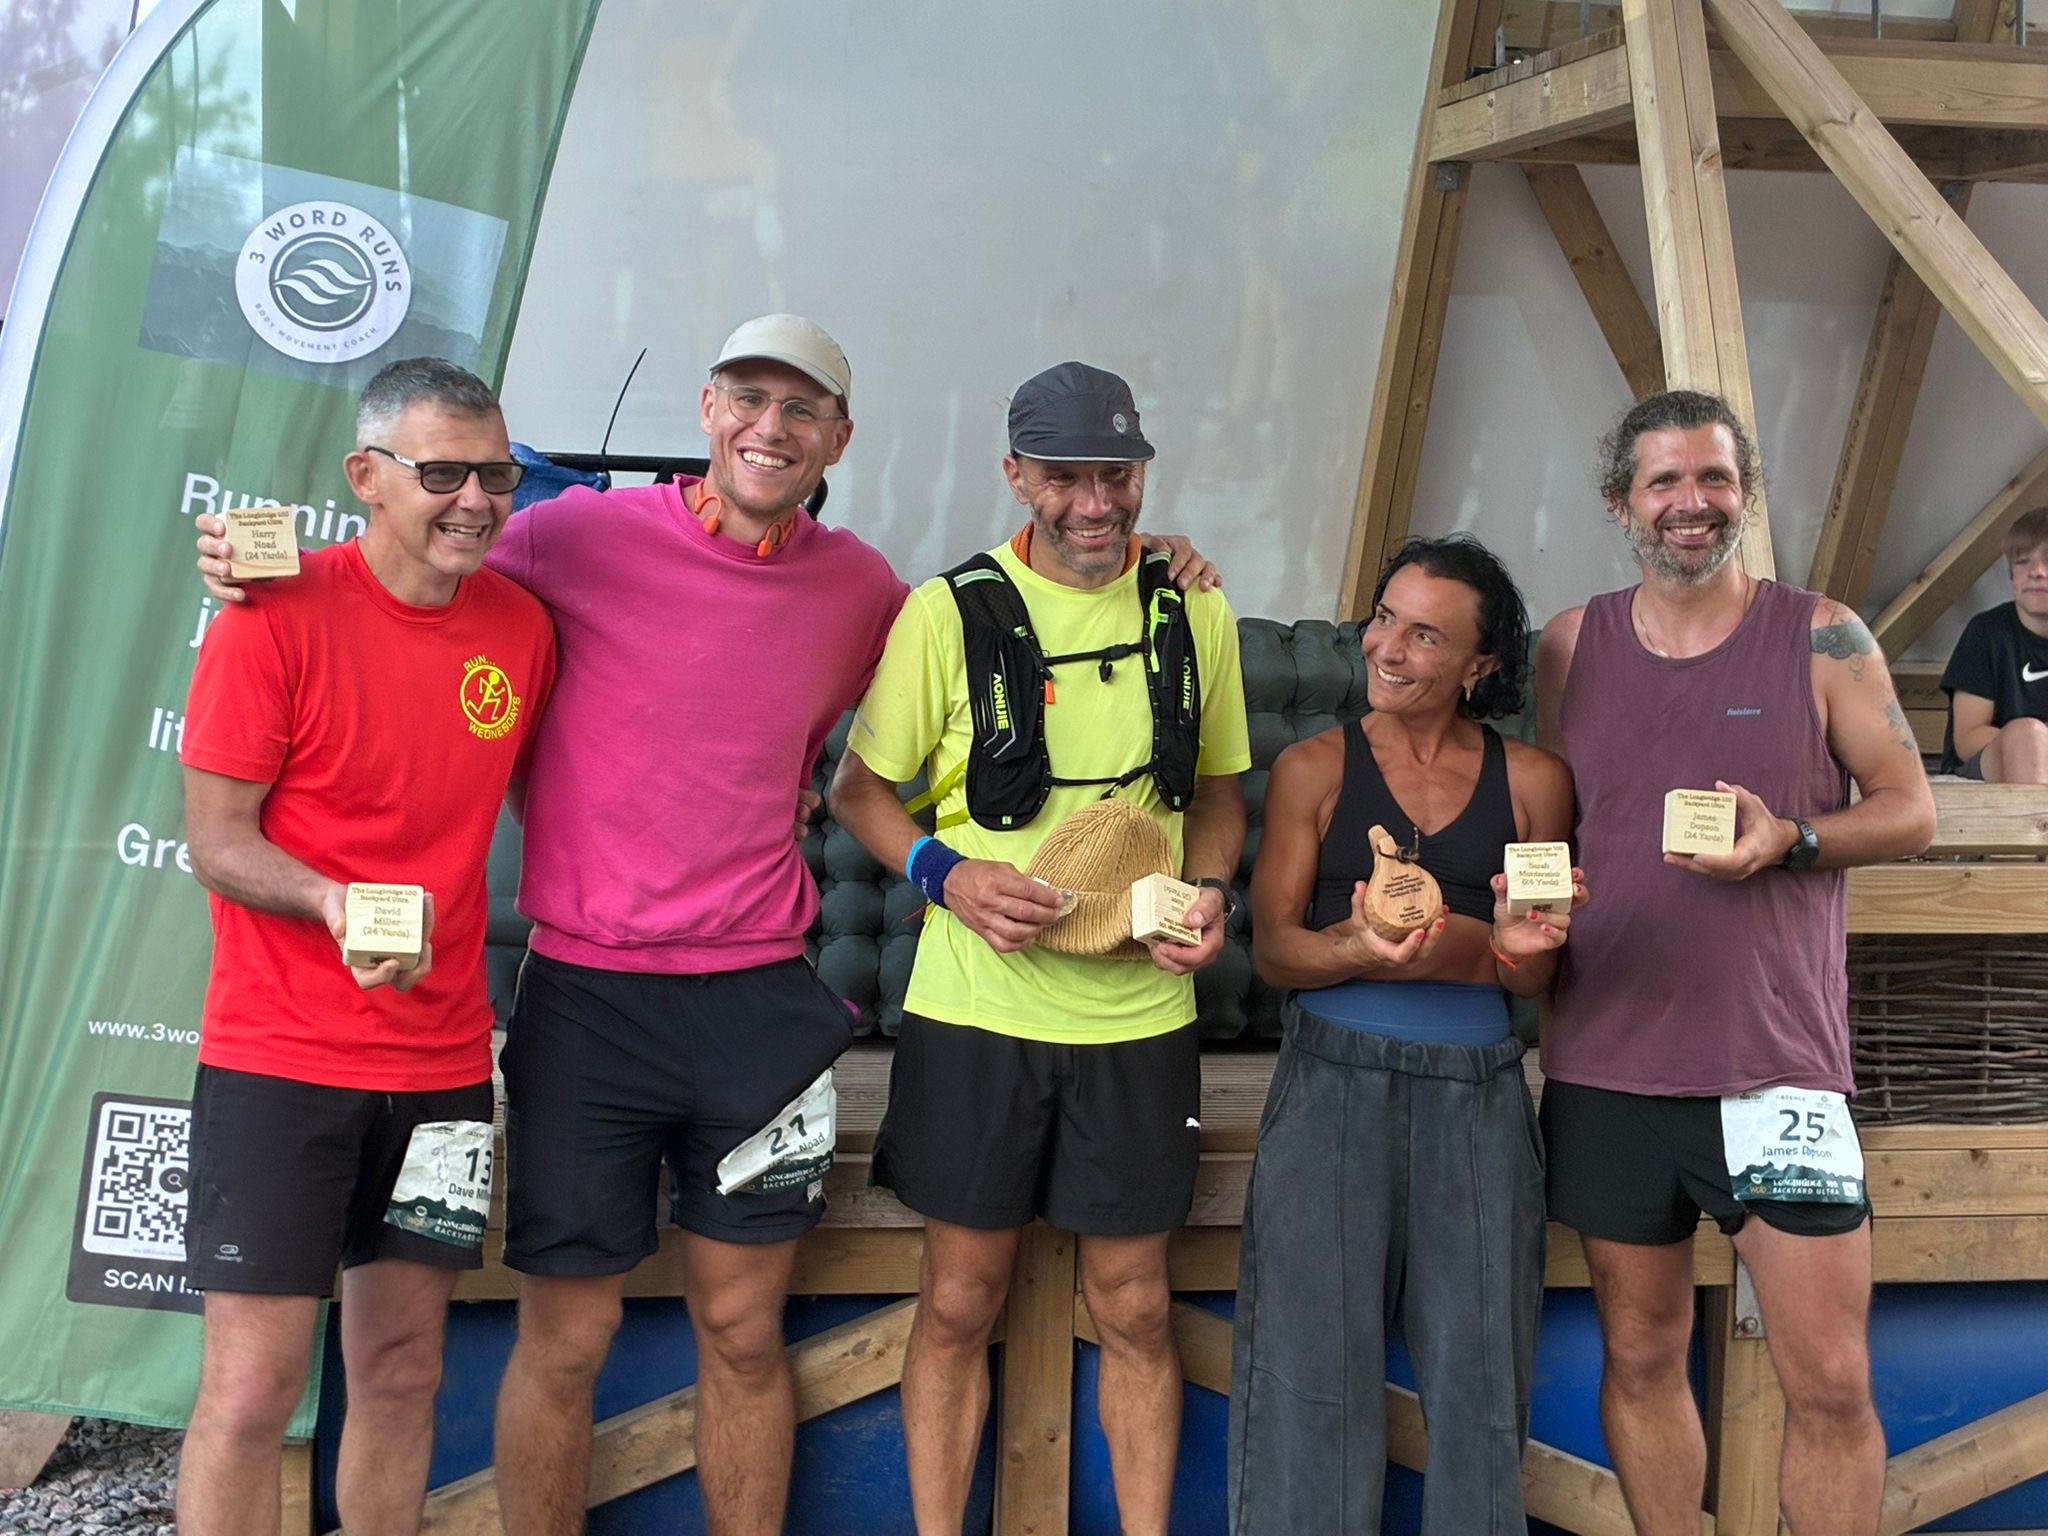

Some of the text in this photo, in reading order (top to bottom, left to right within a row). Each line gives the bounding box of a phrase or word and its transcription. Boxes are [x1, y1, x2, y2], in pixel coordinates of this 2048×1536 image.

[249, 210, 402, 292] 3 WORD RUNS
[255, 303, 377, 351] BODY MOVEMENT COACH
[251, 530, 277, 539] Harry
[245, 550, 288, 561] (24 Yards)
[993, 673, 1010, 730] AONIJIE
[468, 696, 521, 740] WEDNESDAYS
[1693, 812, 1717, 821] James
[373, 917, 401, 926] Miller
[374, 906, 401, 916] David
[363, 926, 379, 936] (24
[88, 1020, 200, 1044] www.3wo
[765, 1113, 808, 1156] 21
[1779, 1109, 1826, 1143] 25
[798, 1132, 826, 1153] Noad
[1762, 1145, 1799, 1157] James
[465, 1148, 492, 1186] 13
[448, 1183, 475, 1198] Dave
[1772, 1186, 1814, 1195] BACKYARD
[1816, 1187, 1840, 1196] ULTRA
[103, 1268, 174, 1293] SCAN
